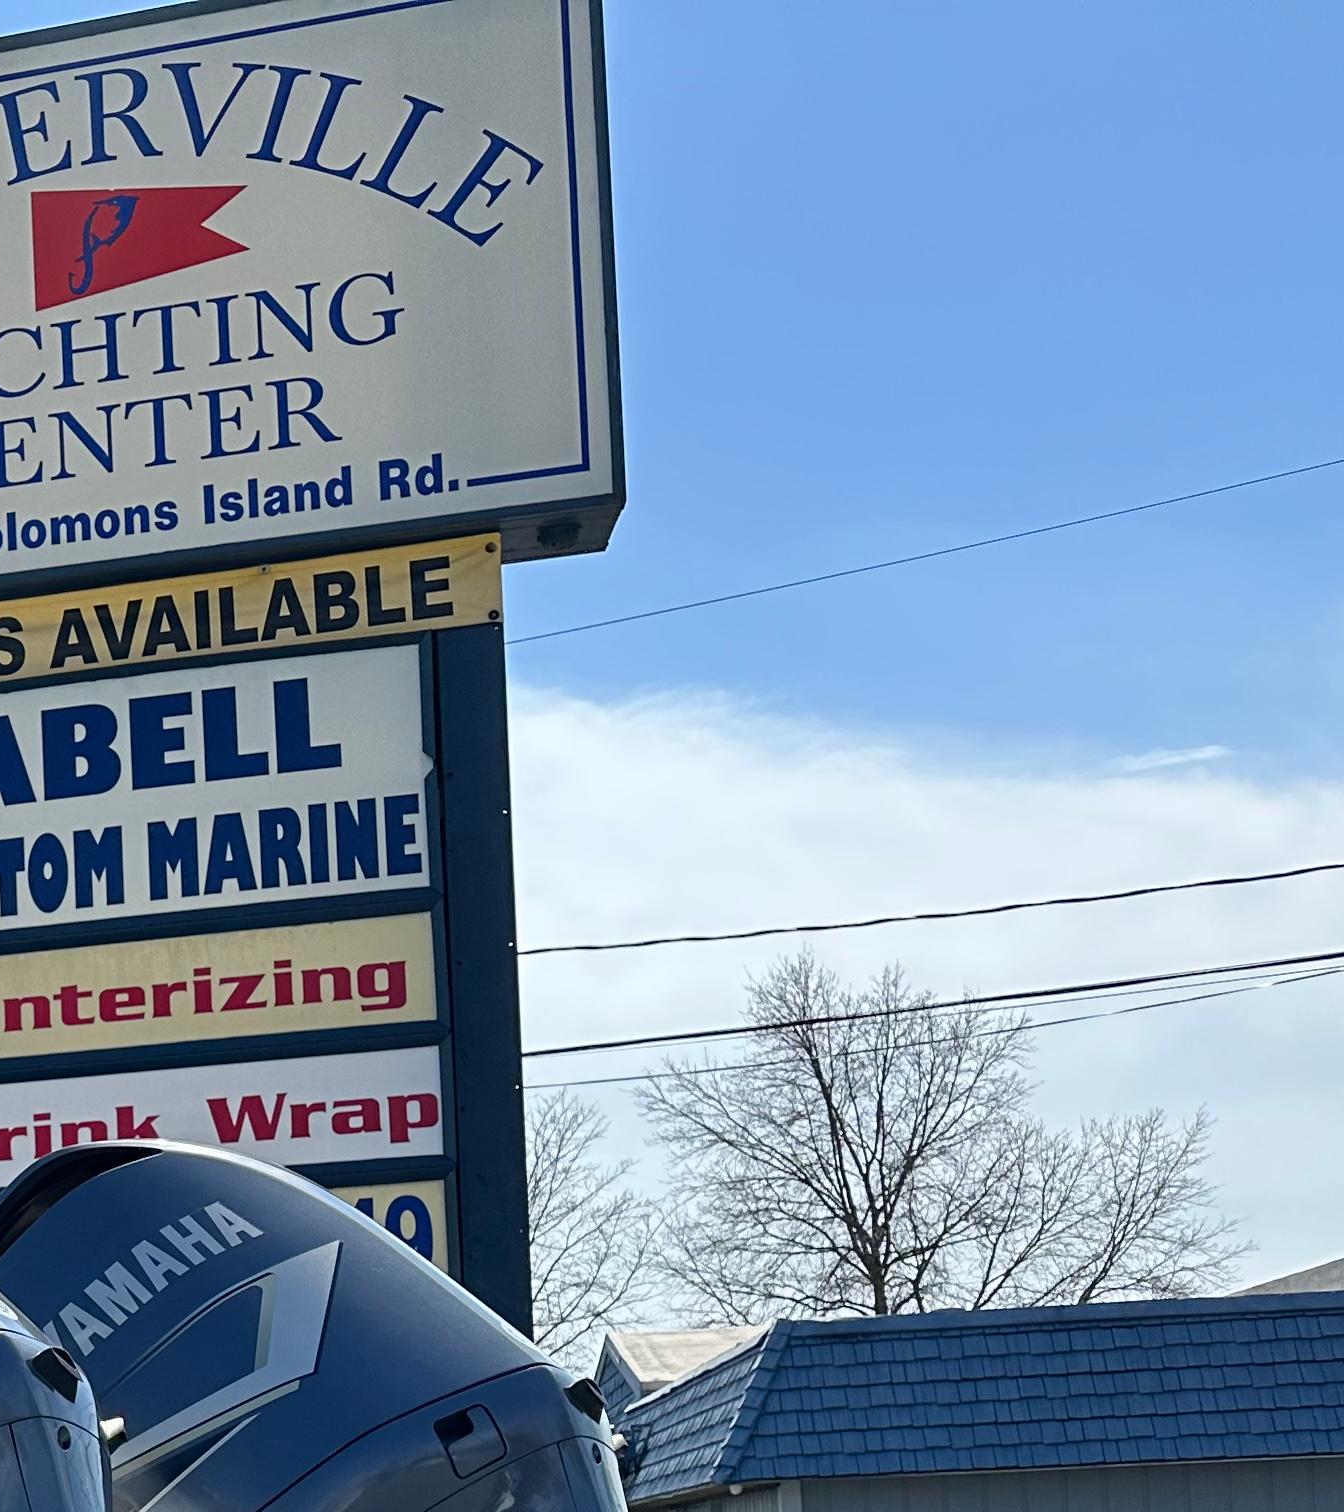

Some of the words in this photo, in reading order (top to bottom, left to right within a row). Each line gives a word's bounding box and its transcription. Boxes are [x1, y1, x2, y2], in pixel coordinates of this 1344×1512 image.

[202, 465, 356, 525] Island
[378, 453, 461, 501] Rd.
[50, 556, 455, 670] AVAILABLE
[147, 793, 423, 901] MARINE
[206, 1092, 440, 1144] Wrap
